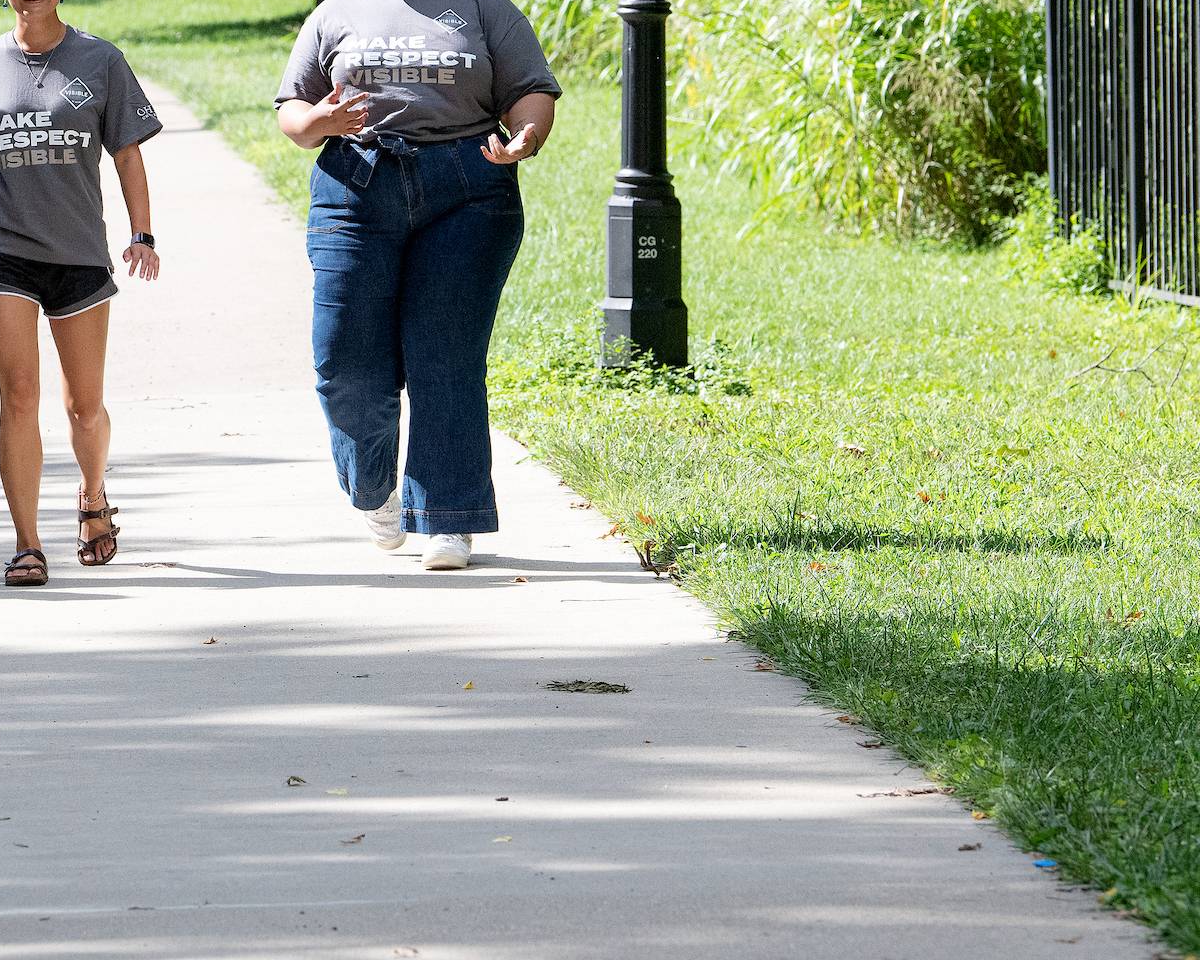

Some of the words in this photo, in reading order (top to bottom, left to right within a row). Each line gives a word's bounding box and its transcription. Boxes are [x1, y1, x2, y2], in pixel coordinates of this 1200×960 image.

[351, 35, 426, 51] MAKE
[344, 51, 477, 69] RESPECT
[349, 68, 456, 86] VISIBLE
[638, 236, 657, 247] CG
[637, 248, 658, 259] 220
